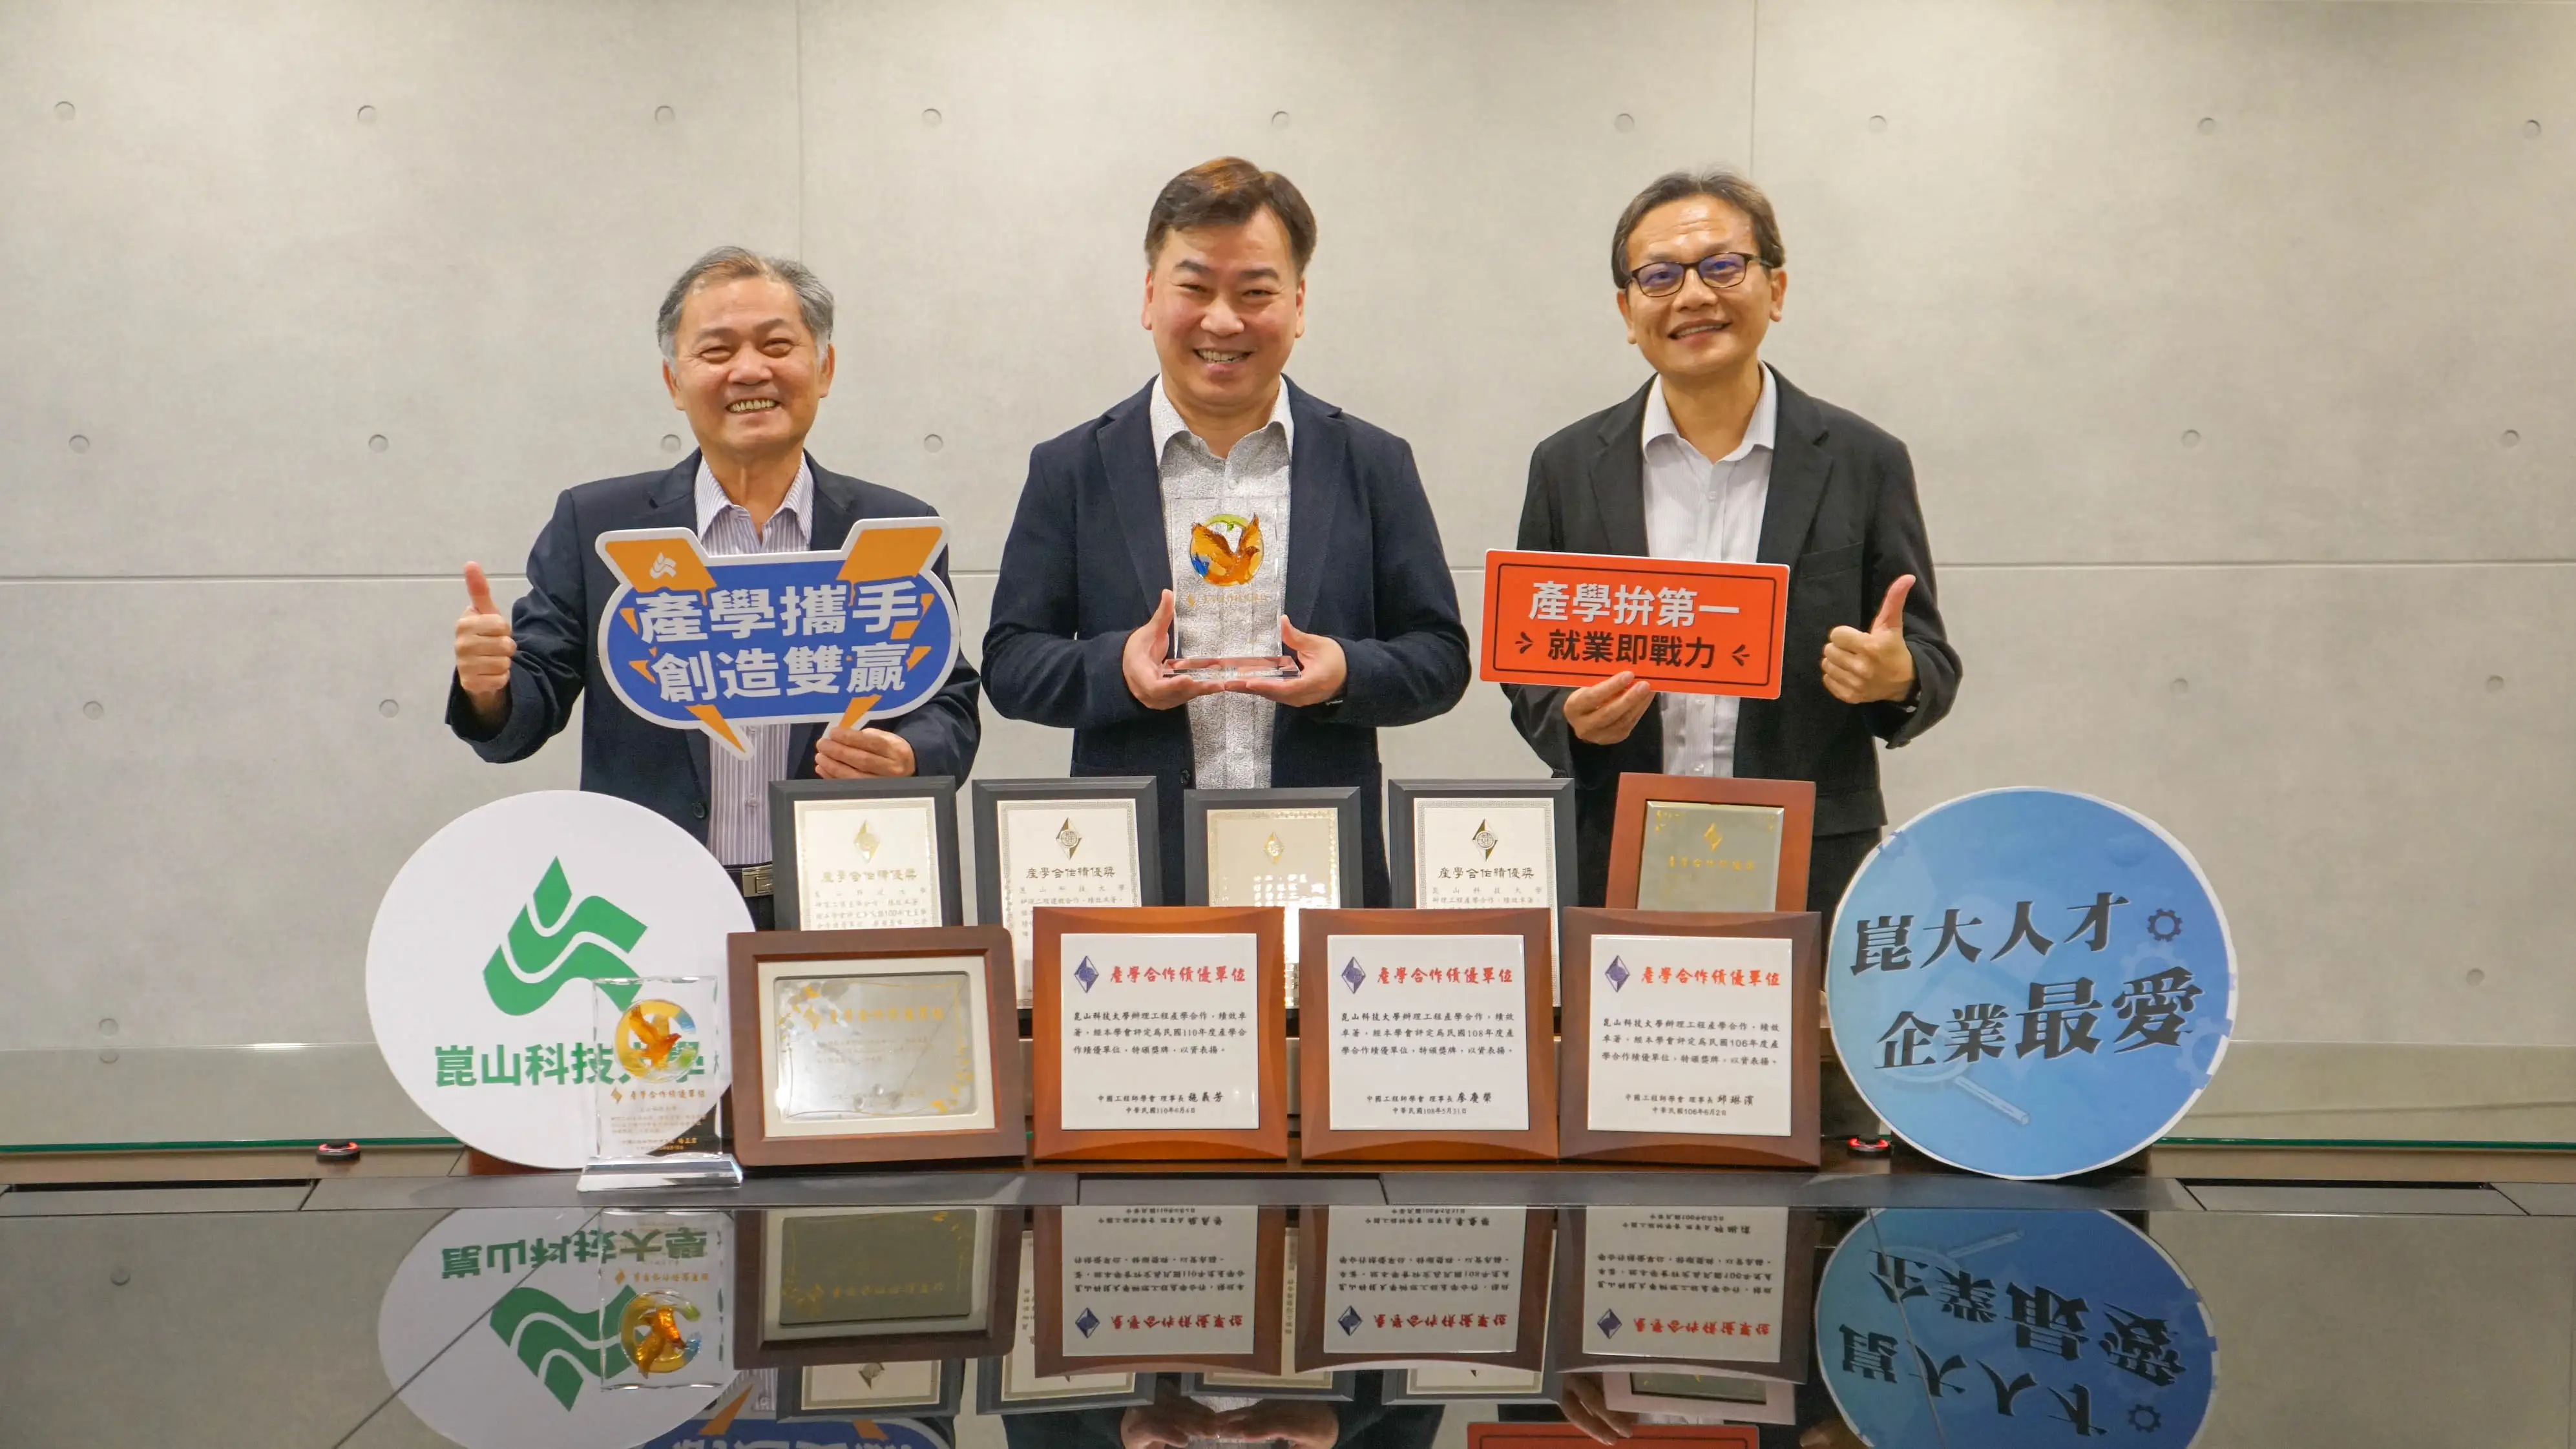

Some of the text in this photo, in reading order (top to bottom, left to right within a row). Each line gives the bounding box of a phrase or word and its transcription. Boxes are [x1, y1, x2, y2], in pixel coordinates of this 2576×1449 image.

[635, 580, 921, 644] 產學攜手
[1529, 581, 1739, 628] 產學拚第一
[1547, 629, 1715, 669] 就業即戰力
[652, 642, 910, 702] 創造雙贏
[1850, 891, 2130, 976] 崑大人才
[1110, 965, 1246, 984] 產學合作績優單位
[1377, 966, 1513, 985] 產學合作績優單位
[1641, 966, 1781, 987] 產學合作績優單位
[1874, 966, 2203, 1070] 企業最愛
[1689, 1096, 1713, 1104] 理事長
